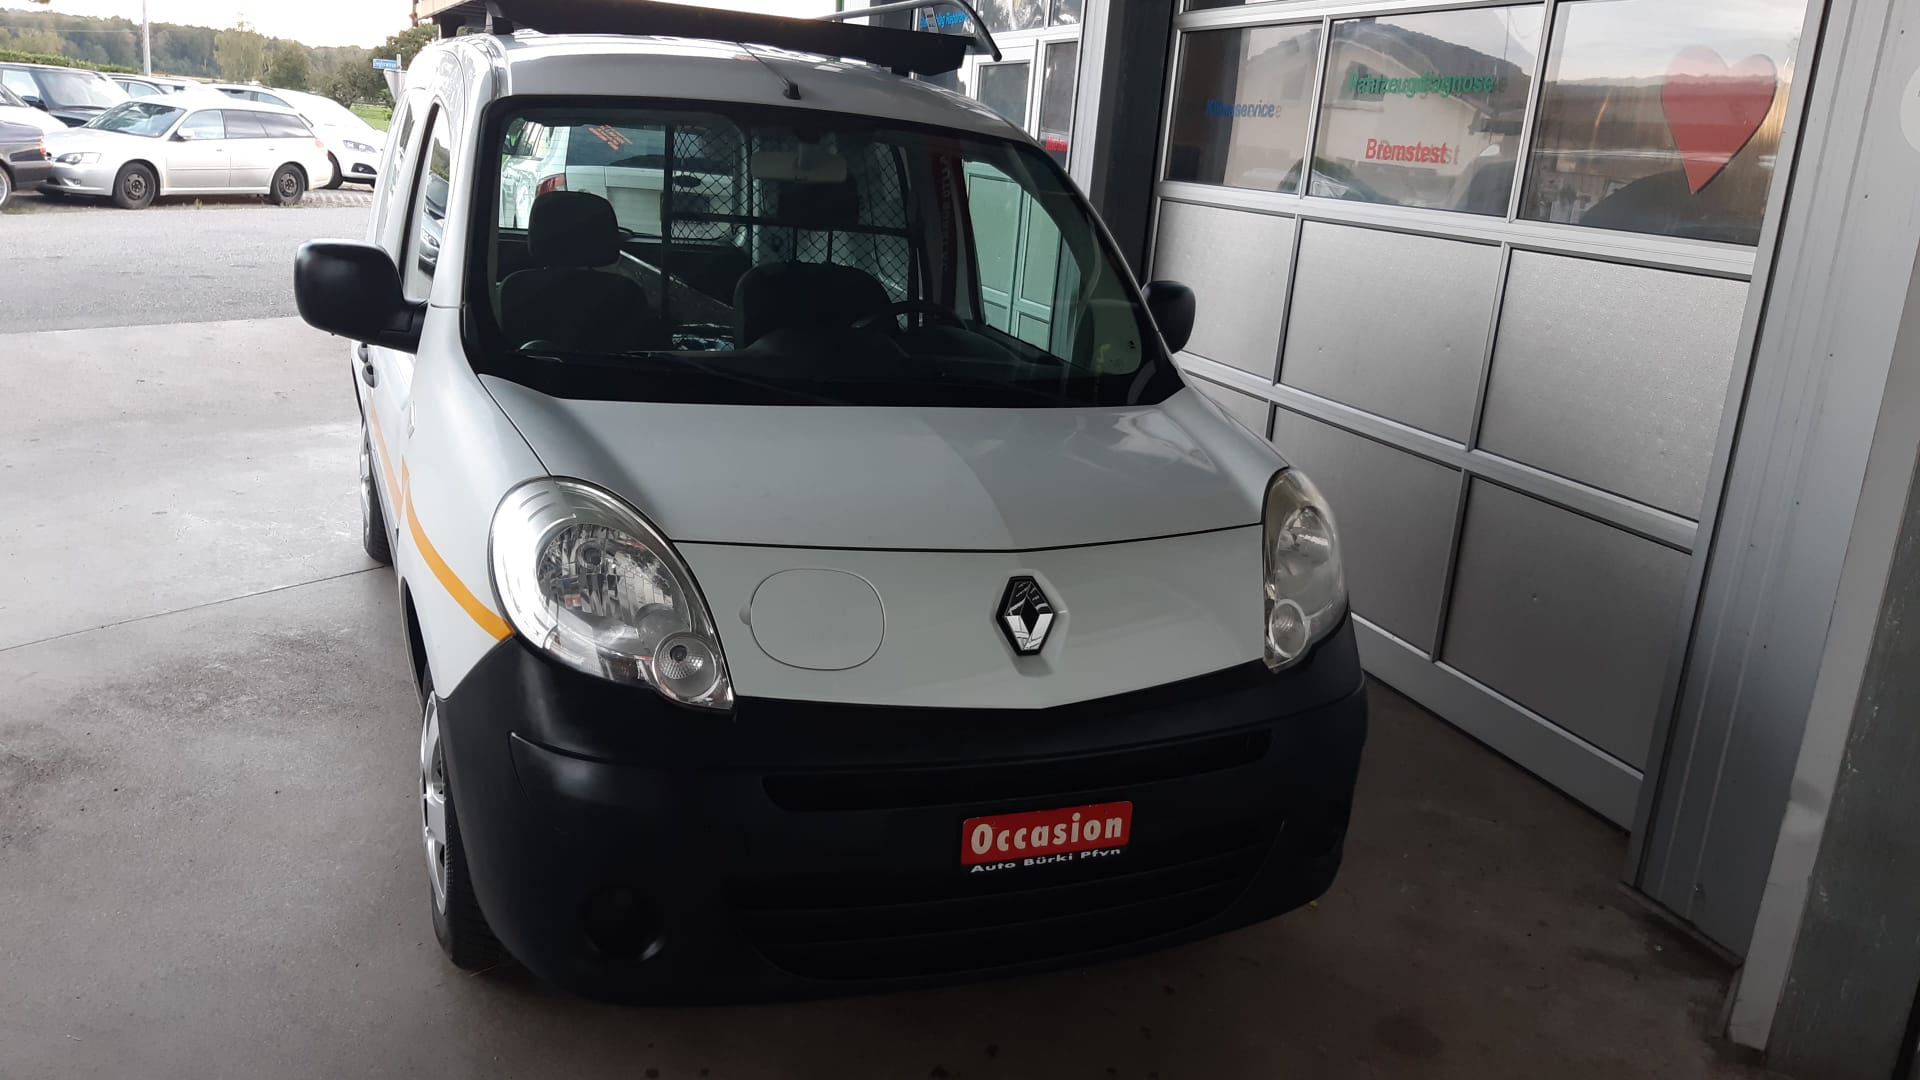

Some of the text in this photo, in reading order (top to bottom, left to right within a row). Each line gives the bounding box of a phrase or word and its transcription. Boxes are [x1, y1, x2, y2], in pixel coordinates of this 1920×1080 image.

[1365, 138, 1448, 164] Bremstest
[970, 812, 1123, 855] Occasion
[970, 848, 1121, 873] Auto Bürki Pfyn
